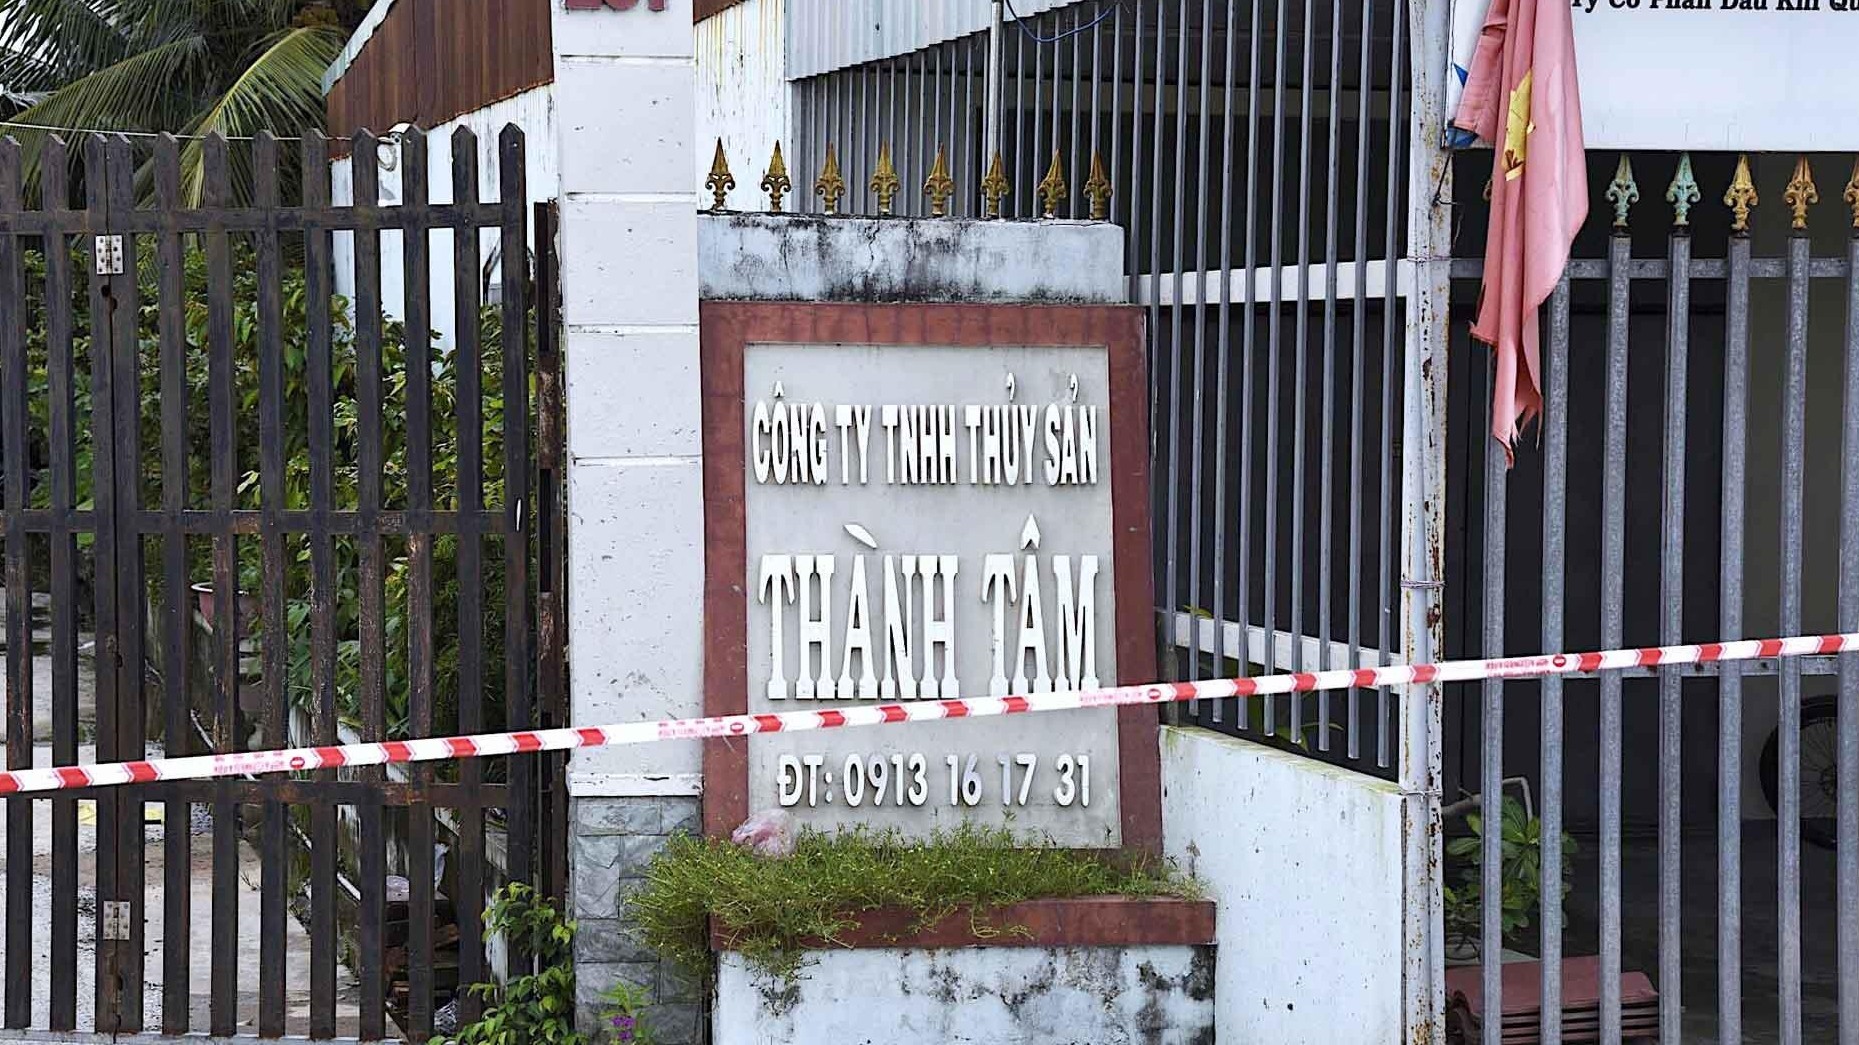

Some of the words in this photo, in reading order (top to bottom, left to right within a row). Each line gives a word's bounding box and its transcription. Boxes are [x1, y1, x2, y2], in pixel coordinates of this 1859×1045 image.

[752, 380, 828, 485] CÔNG
[835, 404, 872, 484] TY
[881, 404, 958, 484] TNHH
[964, 372, 1038, 486] THỦY
[1043, 373, 1098, 486] SẢN
[758, 523, 960, 699] THÀNH
[981, 512, 1100, 697] TÂM
[947, 754, 983, 806] 16
[999, 754, 1037, 806] 17
[1054, 754, 1090, 806] 31
